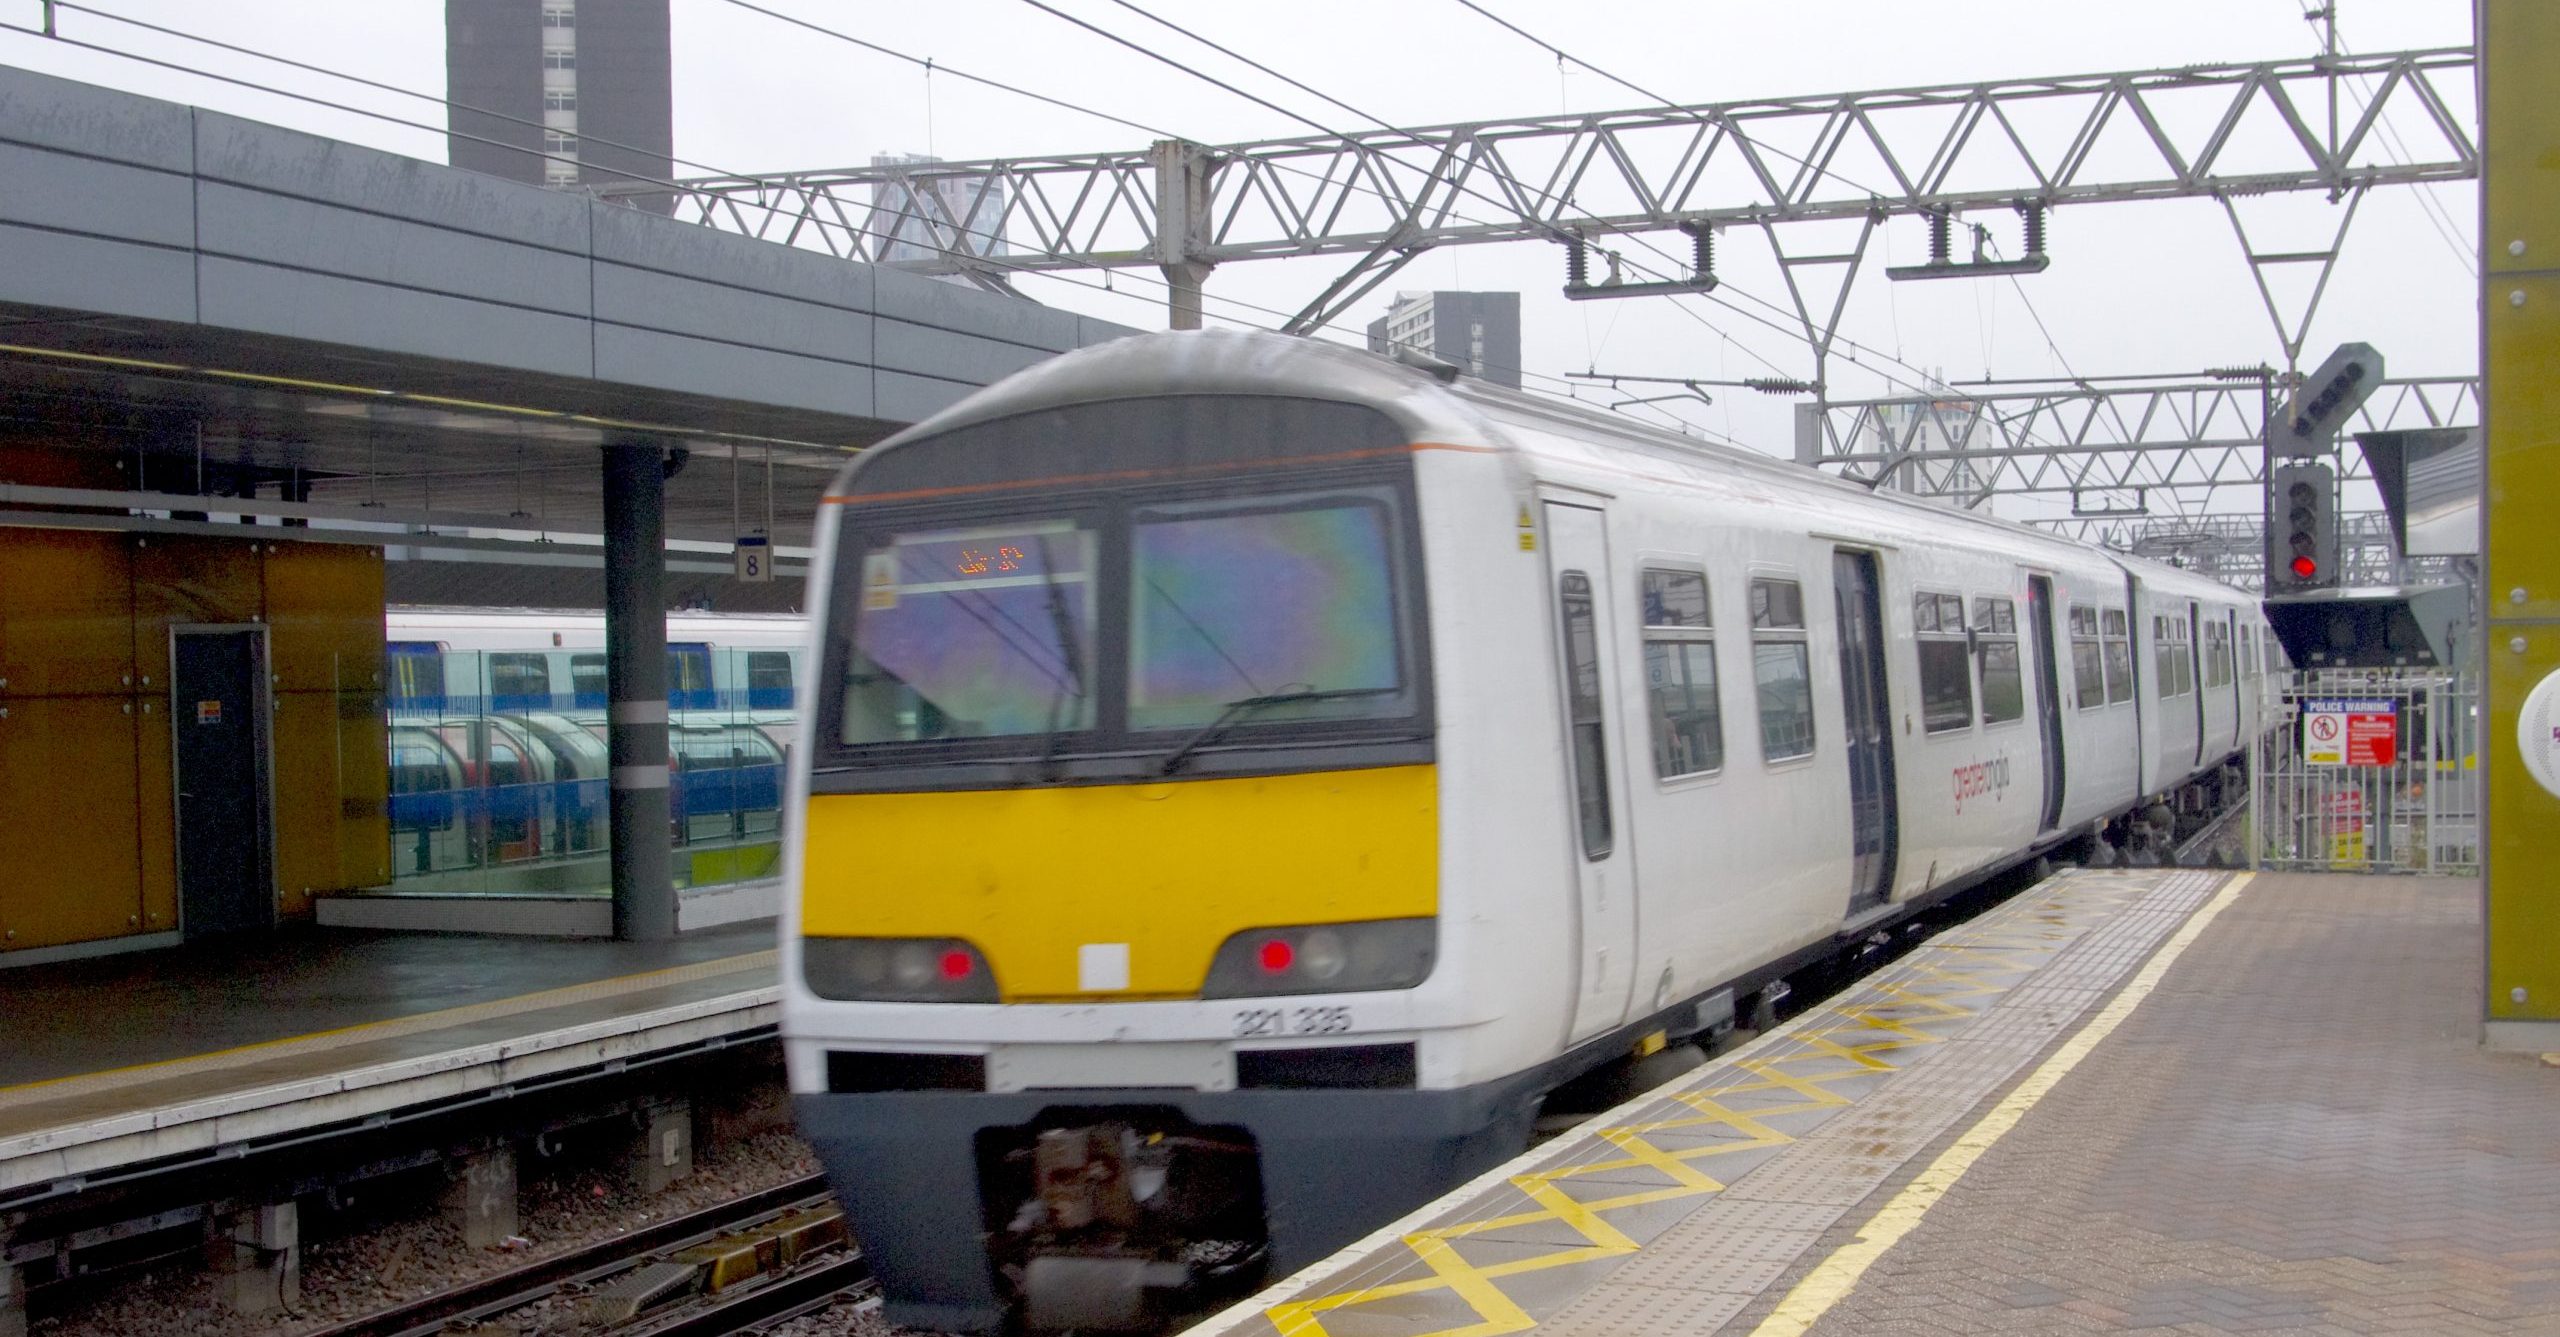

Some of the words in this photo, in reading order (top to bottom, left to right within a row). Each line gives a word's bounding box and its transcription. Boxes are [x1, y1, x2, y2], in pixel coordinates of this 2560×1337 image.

[746, 555, 759, 576] 8
[2309, 702, 2343, 712] POLICE
[2345, 702, 2390, 712] WARNING
[1953, 749, 2010, 816] greateranglia
[1234, 1008, 1284, 1035] 321
[1294, 1005, 1353, 1032] 335
